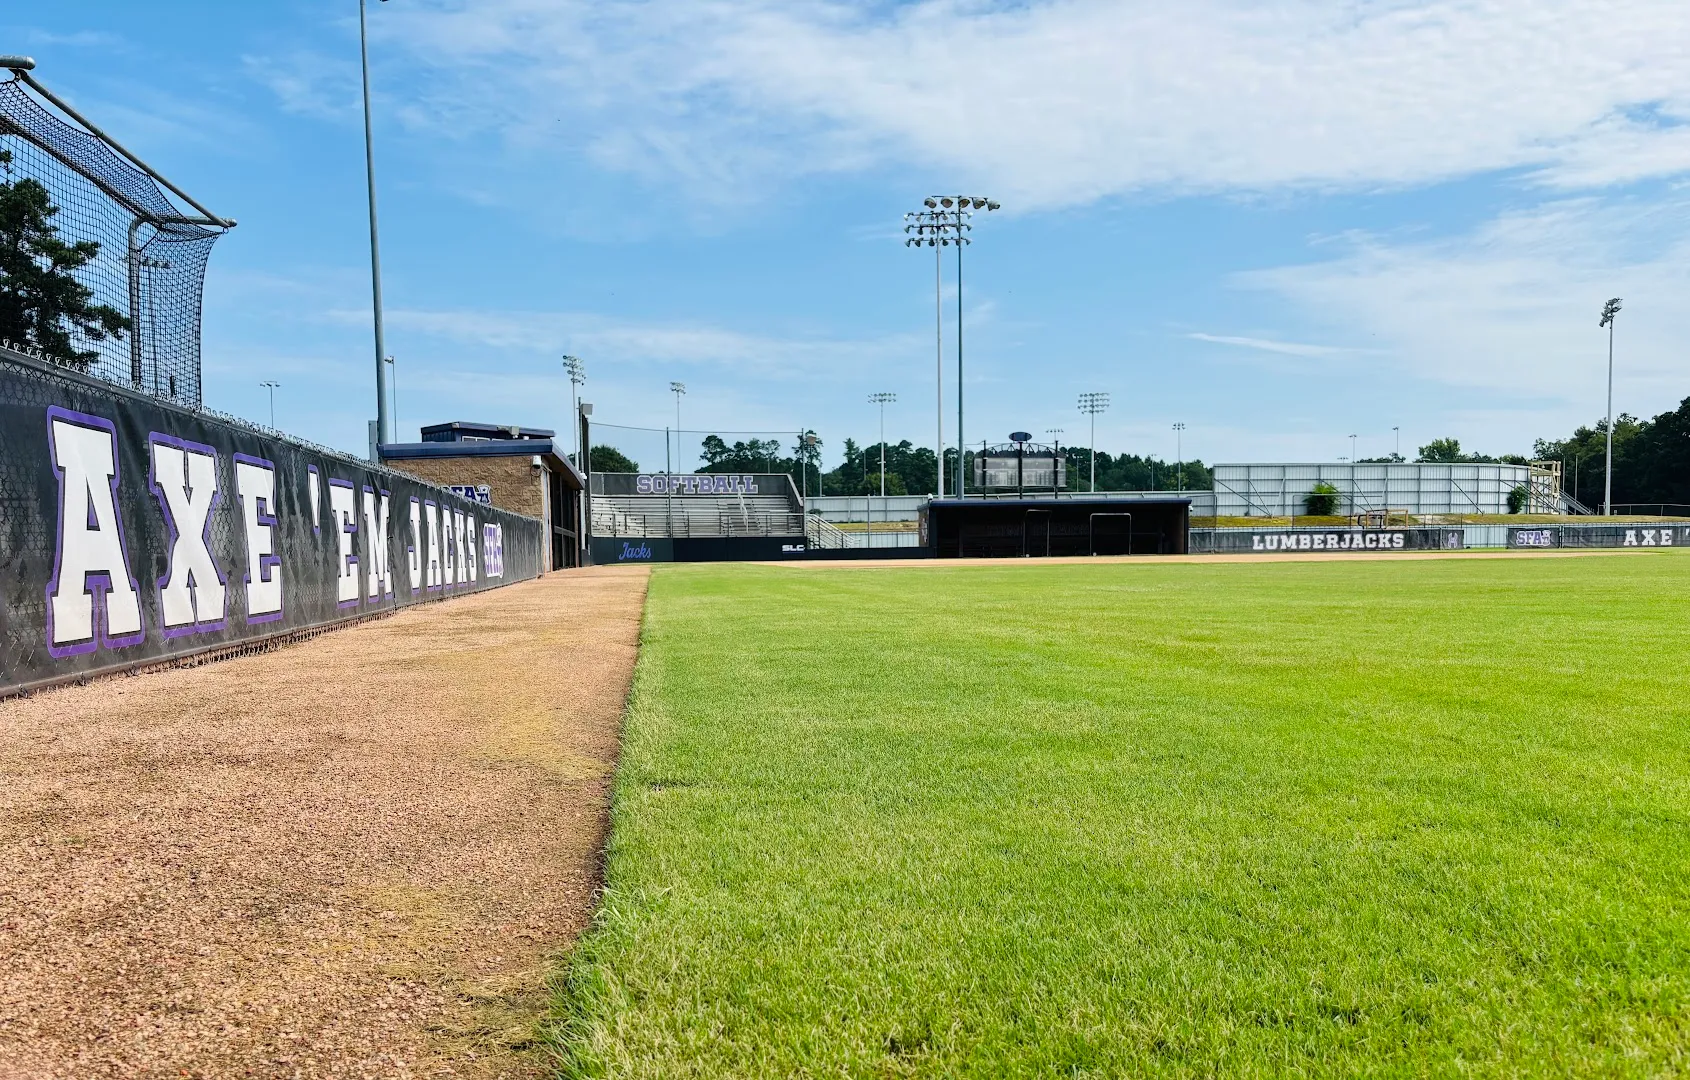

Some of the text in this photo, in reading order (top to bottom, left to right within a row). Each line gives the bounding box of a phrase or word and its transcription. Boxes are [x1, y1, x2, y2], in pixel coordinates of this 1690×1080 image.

[637, 475, 758, 494] SOFTBALL
[47, 405, 477, 658] AXE 'EM JACKS
[1517, 531, 1544, 546] SFA
[1623, 529, 1672, 546] AXE
[782, 544, 805, 552] SLC
[1252, 534, 1404, 550] LUMBERJACKS
[619, 542, 651, 560] Jacks
